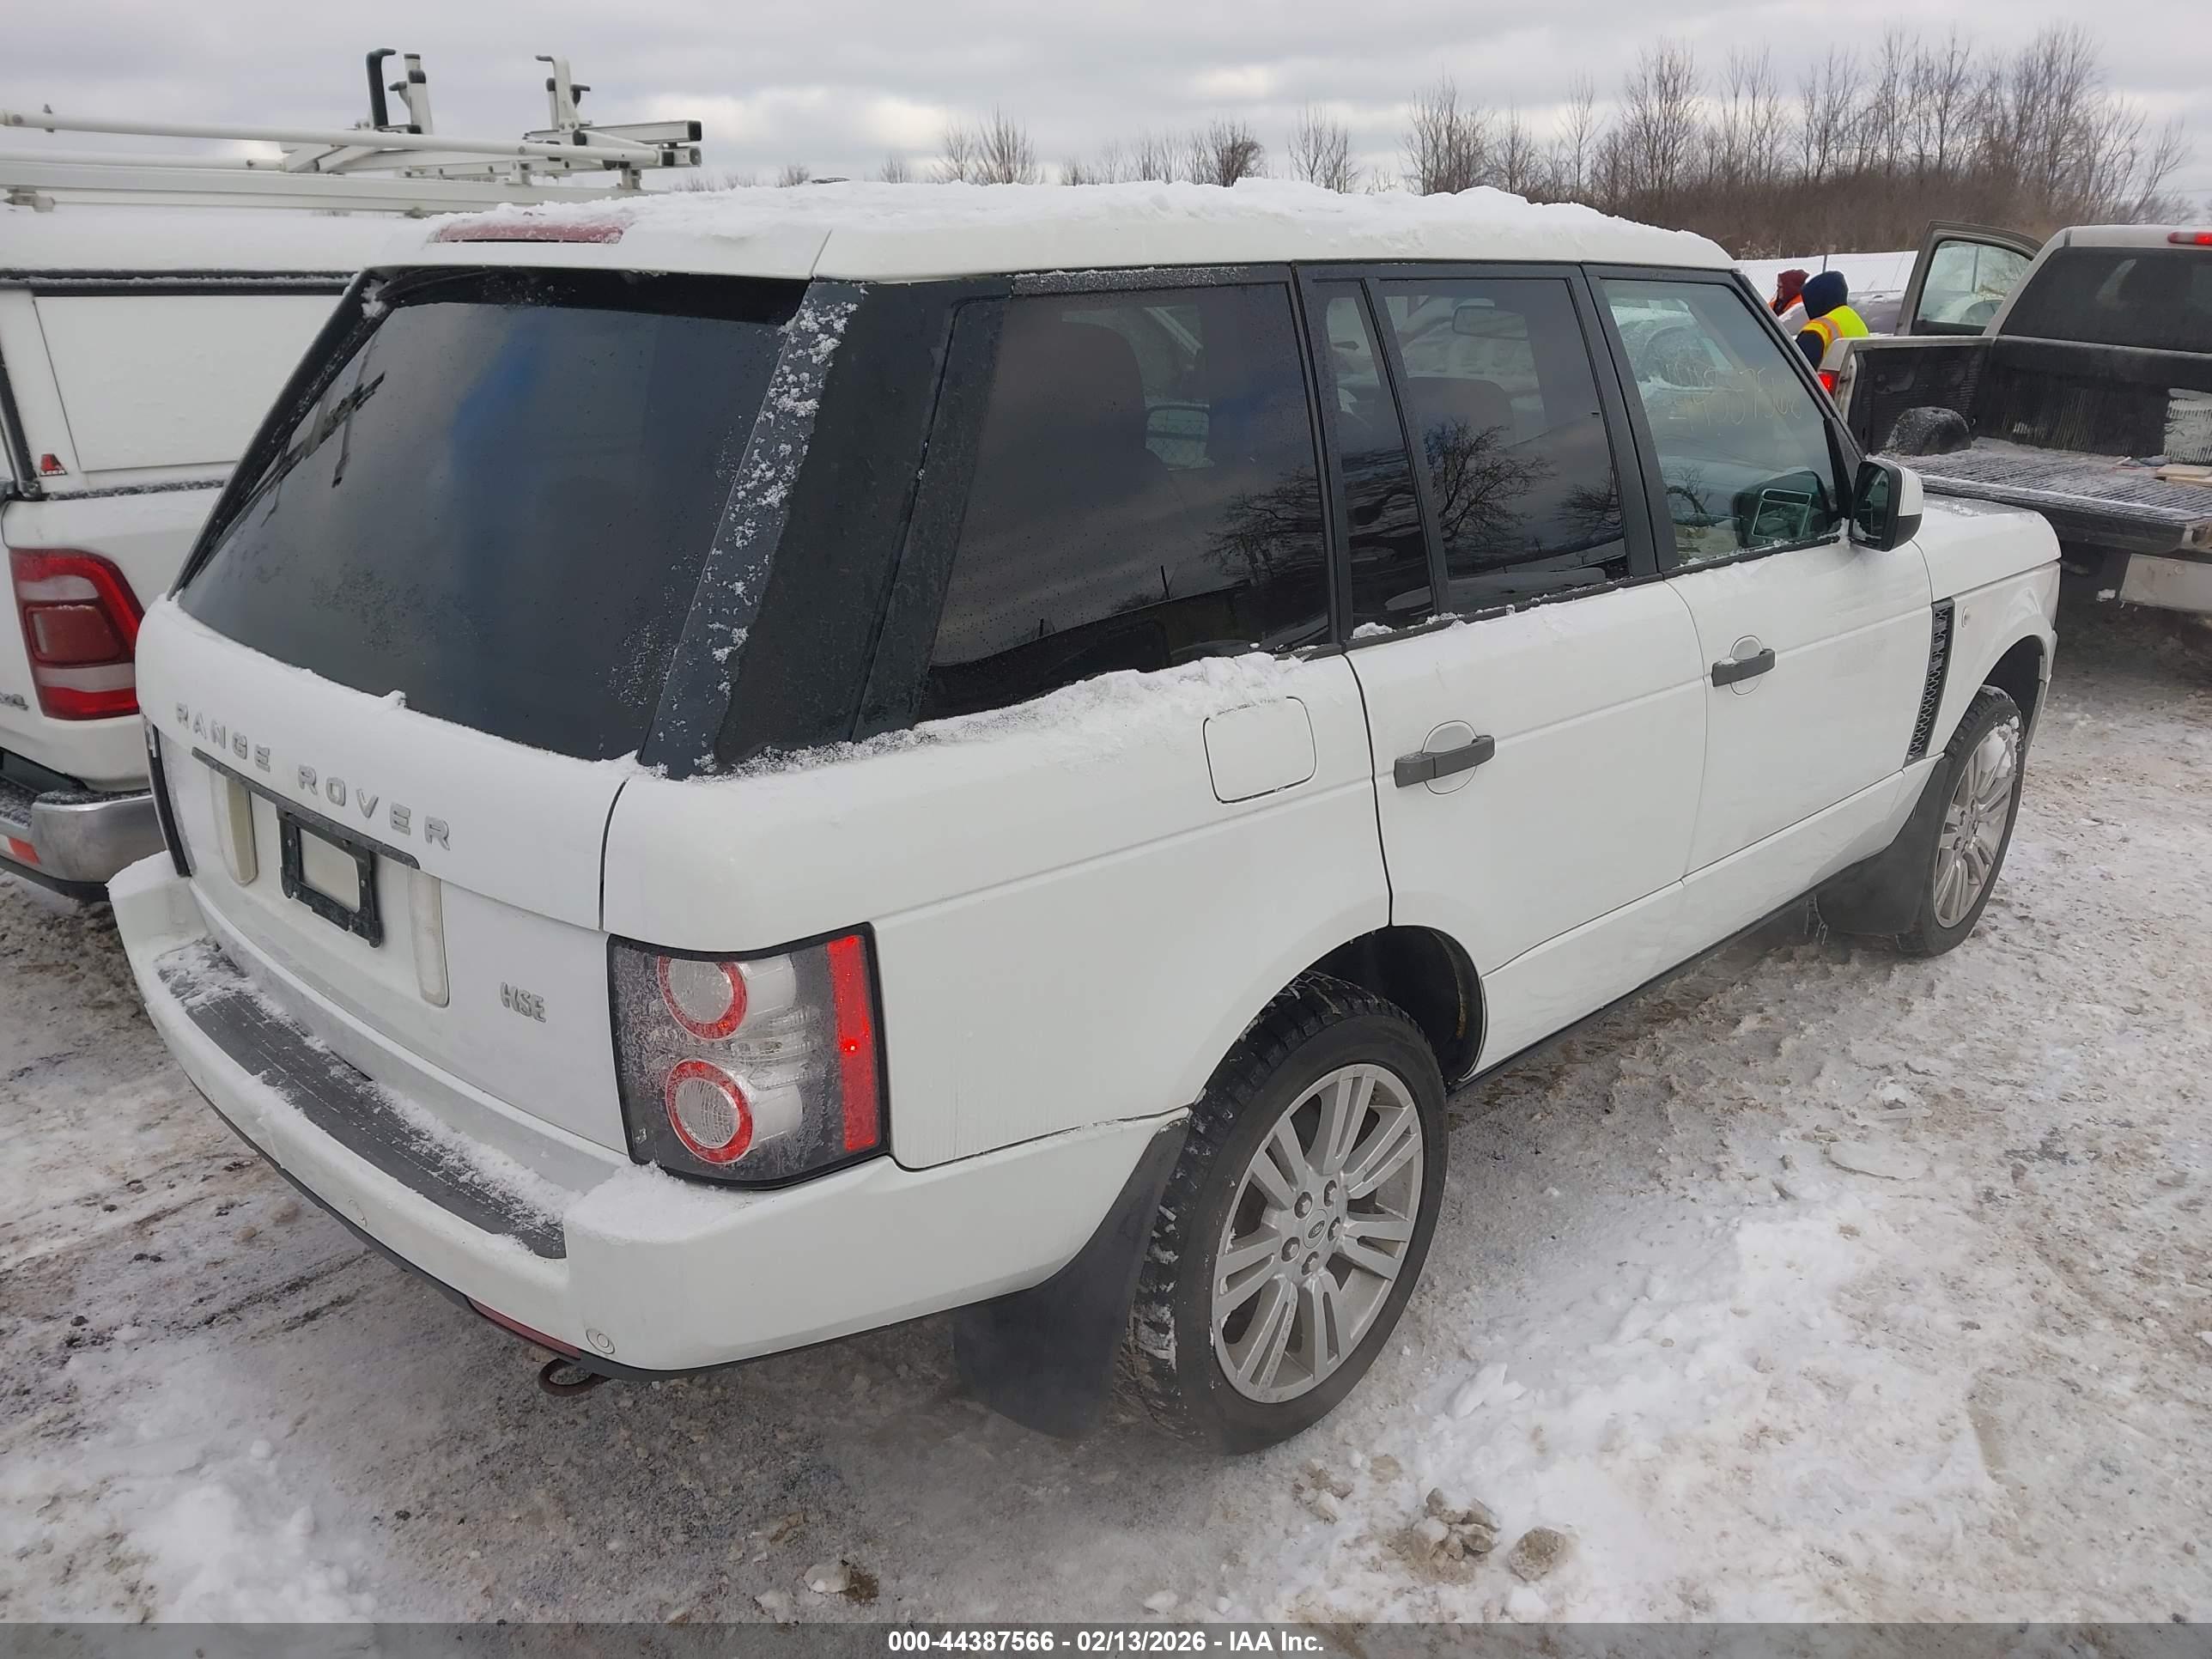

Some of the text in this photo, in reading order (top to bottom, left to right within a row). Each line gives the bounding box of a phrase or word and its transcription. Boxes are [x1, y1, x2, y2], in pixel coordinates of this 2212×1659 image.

[176, 702, 451, 851] RANGE ROVER
[500, 981, 547, 1023] HSE
